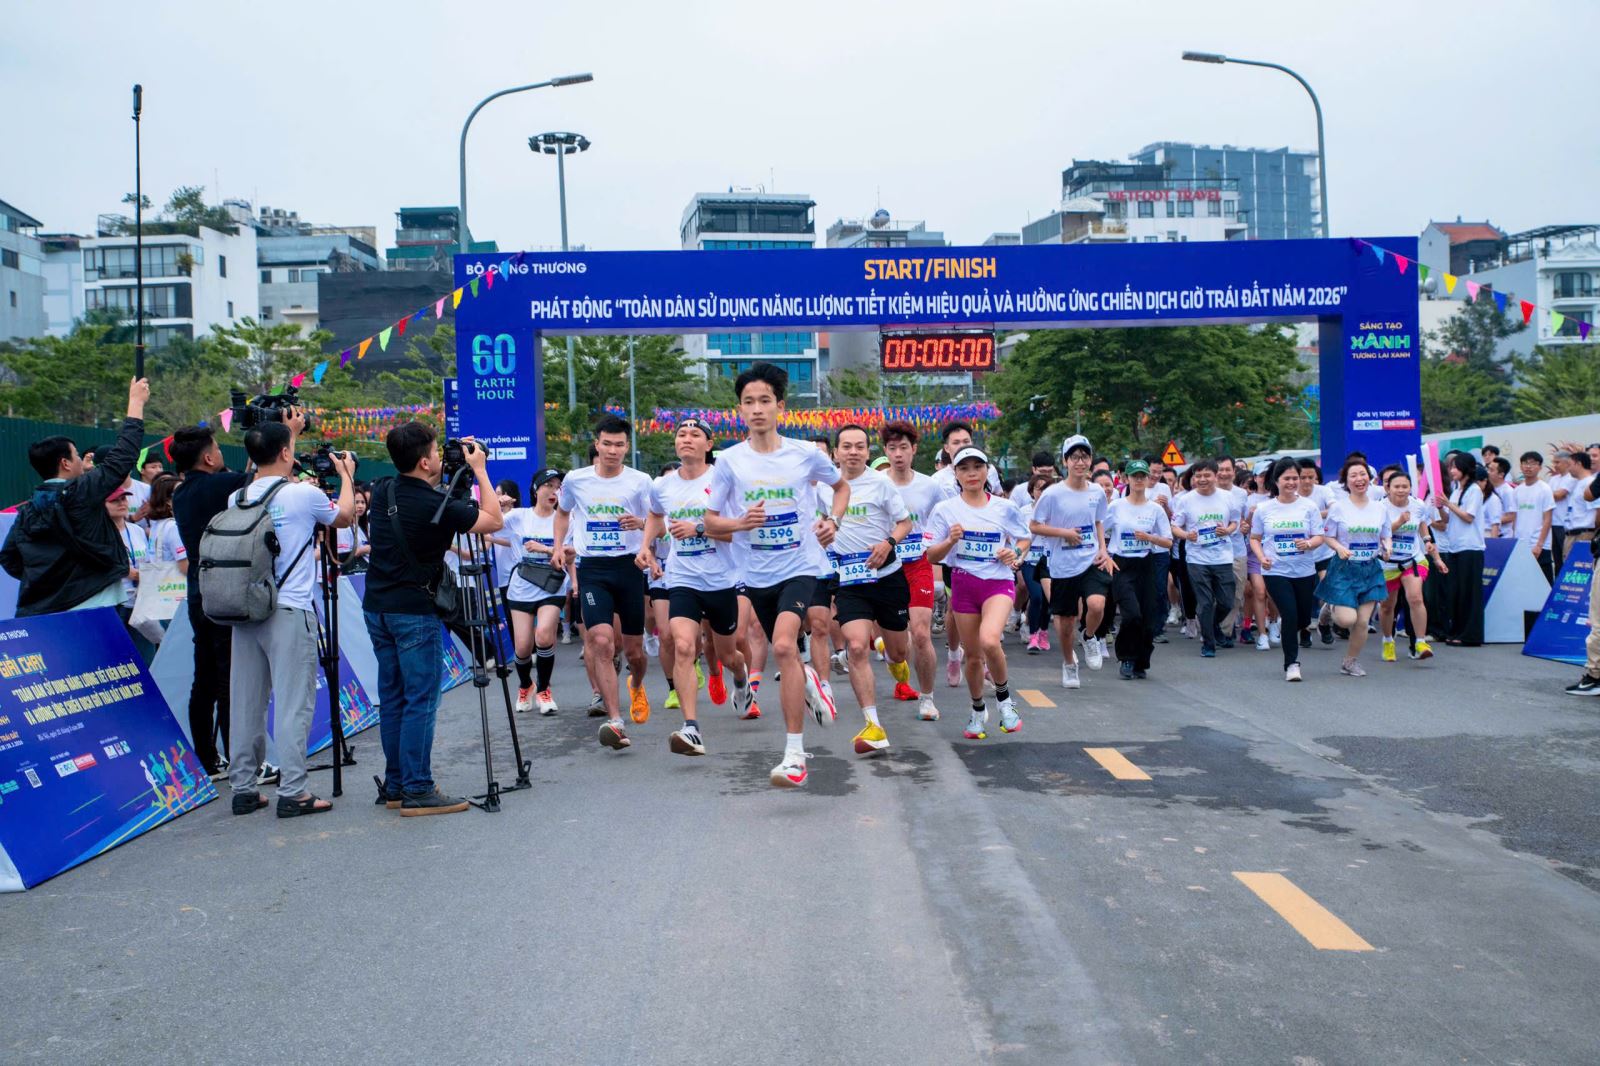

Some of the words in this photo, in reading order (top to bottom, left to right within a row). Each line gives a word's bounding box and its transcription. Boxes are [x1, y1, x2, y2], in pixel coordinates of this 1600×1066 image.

[1108, 191, 1170, 201] VIETFOOT
[1177, 190, 1221, 201] TRAVEL
[466, 261, 484, 277] BỘ
[488, 263, 529, 274] CNG
[532, 261, 587, 274] THƯƠNG
[864, 257, 996, 282] START/FINISH
[531, 296, 570, 319] PHÁT
[572, 295, 612, 323] ĐỘNG
[615, 295, 662, 318] “TOÀN
[665, 294, 695, 317] DÂN
[698, 292, 717, 317] SỬ
[720, 298, 759, 322] DỤNG
[762, 293, 803, 316] NĂNG
[806, 294, 853, 320] LƯỢNG
[855, 288, 886, 315] TIẾT
[888, 291, 924, 319] KIỆM
[926, 291, 959, 318] HIỆU
[962, 287, 992, 317] QUẢ
[993, 290, 1014, 313] VÀ
[1016, 287, 1066, 312] HƯỞNG
[1069, 288, 1099, 312] ỨNG
[1101, 283, 1143, 311] CHIẾN
[1146, 290, 1178, 314] DỊCH
[1181, 286, 1204, 309] GIỜ
[1206, 285, 1239, 309] TRÁI
[1241, 280, 1270, 308] ĐẤT
[1272, 283, 1305, 306] NĂM
[1308, 286, 1347, 306] 2026”
[1360, 321, 1383, 330] SÁNG
[1385, 321, 1403, 331] TẠO
[472, 333, 516, 375] 60
[884, 338, 992, 368] 00:00:00
[474, 377, 515, 388] EARTH
[477, 389, 515, 400] HOUR
[1371, 411, 1379, 419] VỊ
[1396, 409, 1410, 418] HIỆN
[492, 435, 511, 443] ĐỒNG
[512, 435, 530, 443] HÀNH
[592, 532, 620, 541] 3.443
[757, 527, 793, 539] 3.596
[965, 542, 993, 552] 3.301
